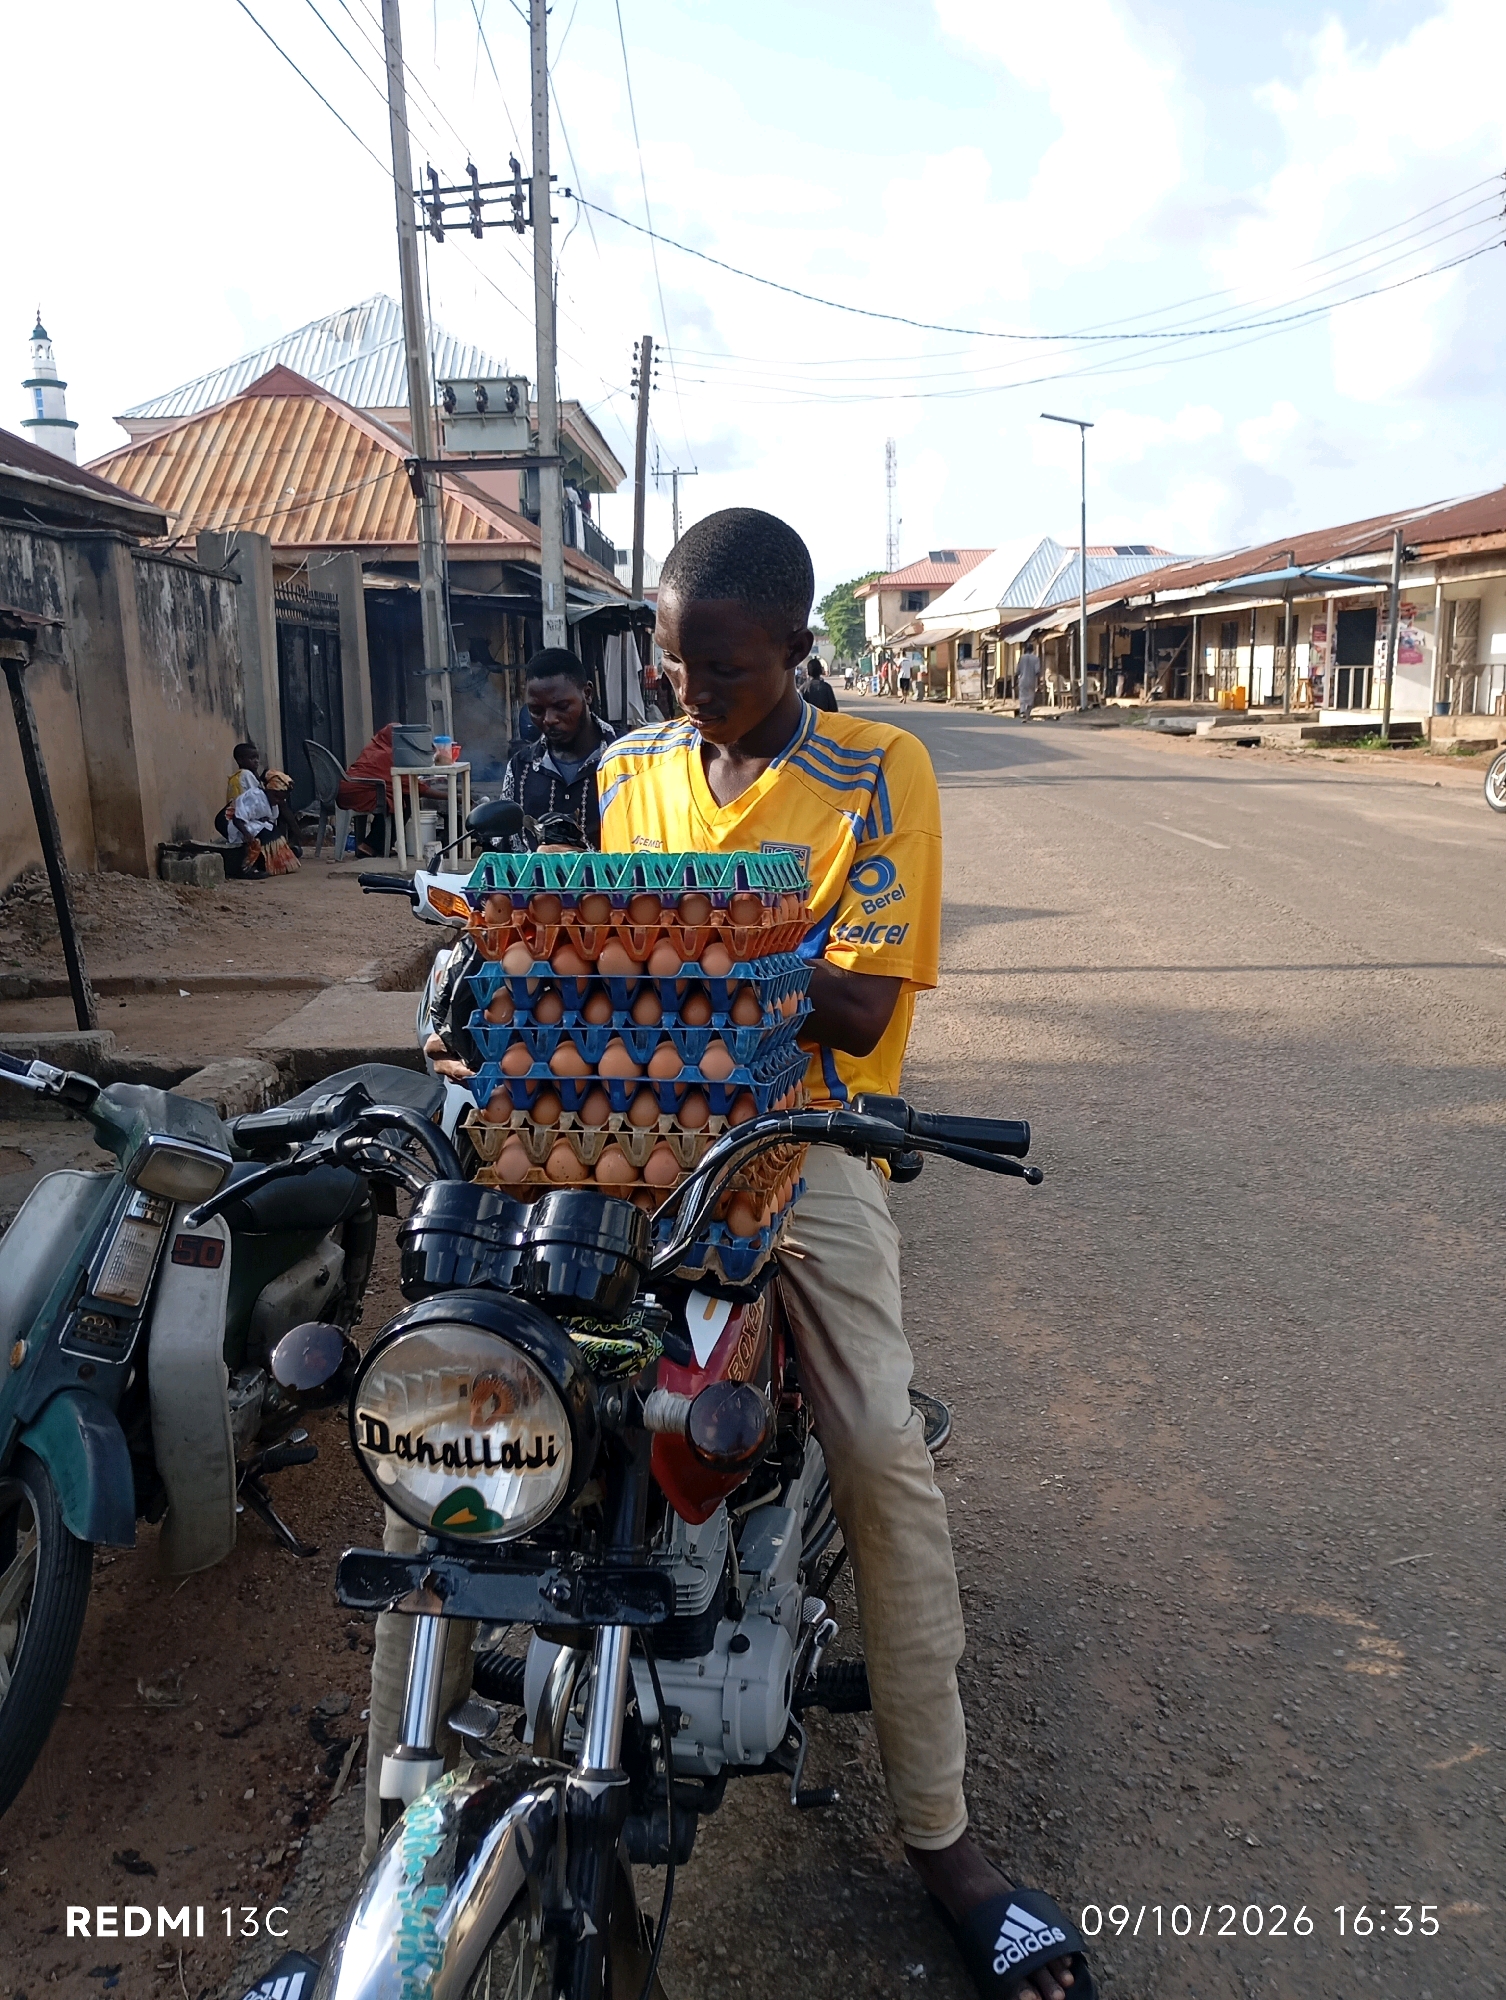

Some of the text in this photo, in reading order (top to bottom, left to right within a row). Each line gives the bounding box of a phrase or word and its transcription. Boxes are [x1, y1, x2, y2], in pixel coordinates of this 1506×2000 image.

[861, 883, 906, 915] Berel
[836, 920, 910, 945] telcel
[173, 1236, 224, 1267] 50
[728, 1299, 763, 1381] BOXE
[993, 1927, 1066, 1975] adidas
